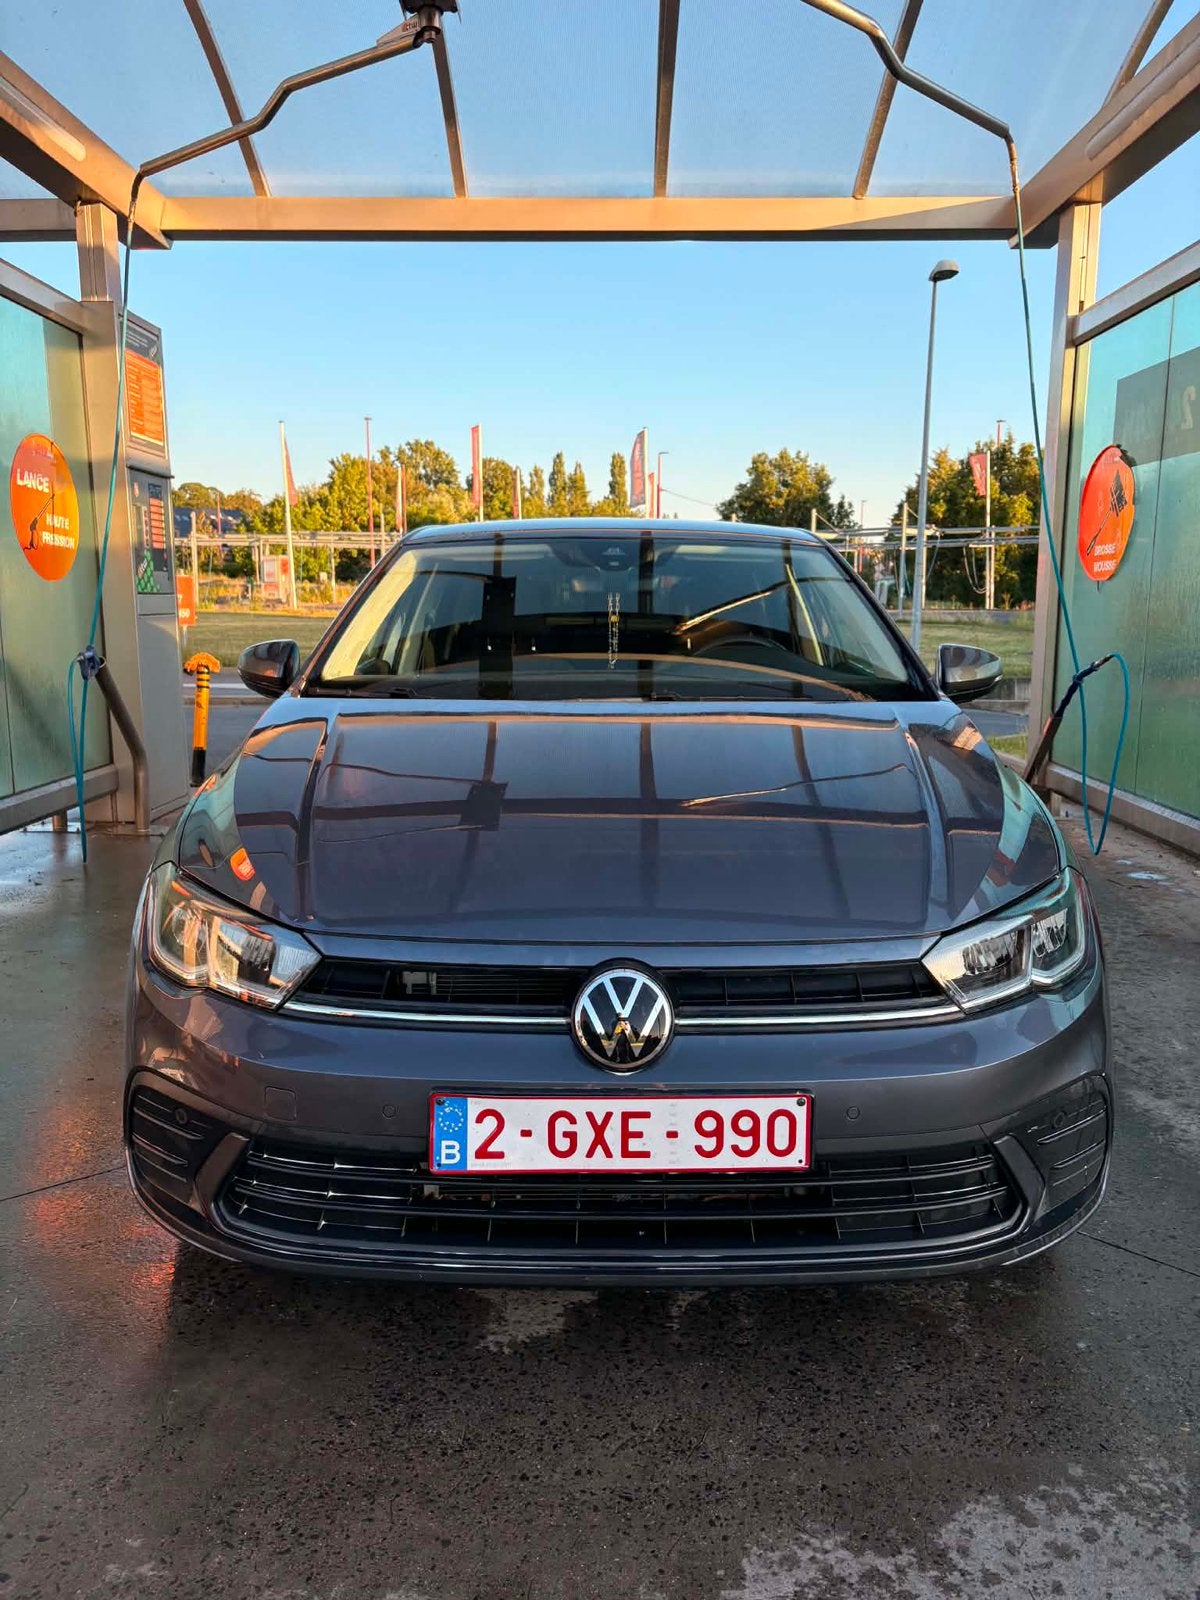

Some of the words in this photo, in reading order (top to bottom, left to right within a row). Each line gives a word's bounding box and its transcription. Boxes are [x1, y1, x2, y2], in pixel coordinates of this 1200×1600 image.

[16, 468, 50, 493] LANCE
[46, 512, 70, 530] HAUTE
[42, 530, 75, 549] PRESSION
[578, 971, 667, 1061] VW
[441, 1139, 461, 1165] B
[474, 1108, 798, 1160] 2-GXE-990
